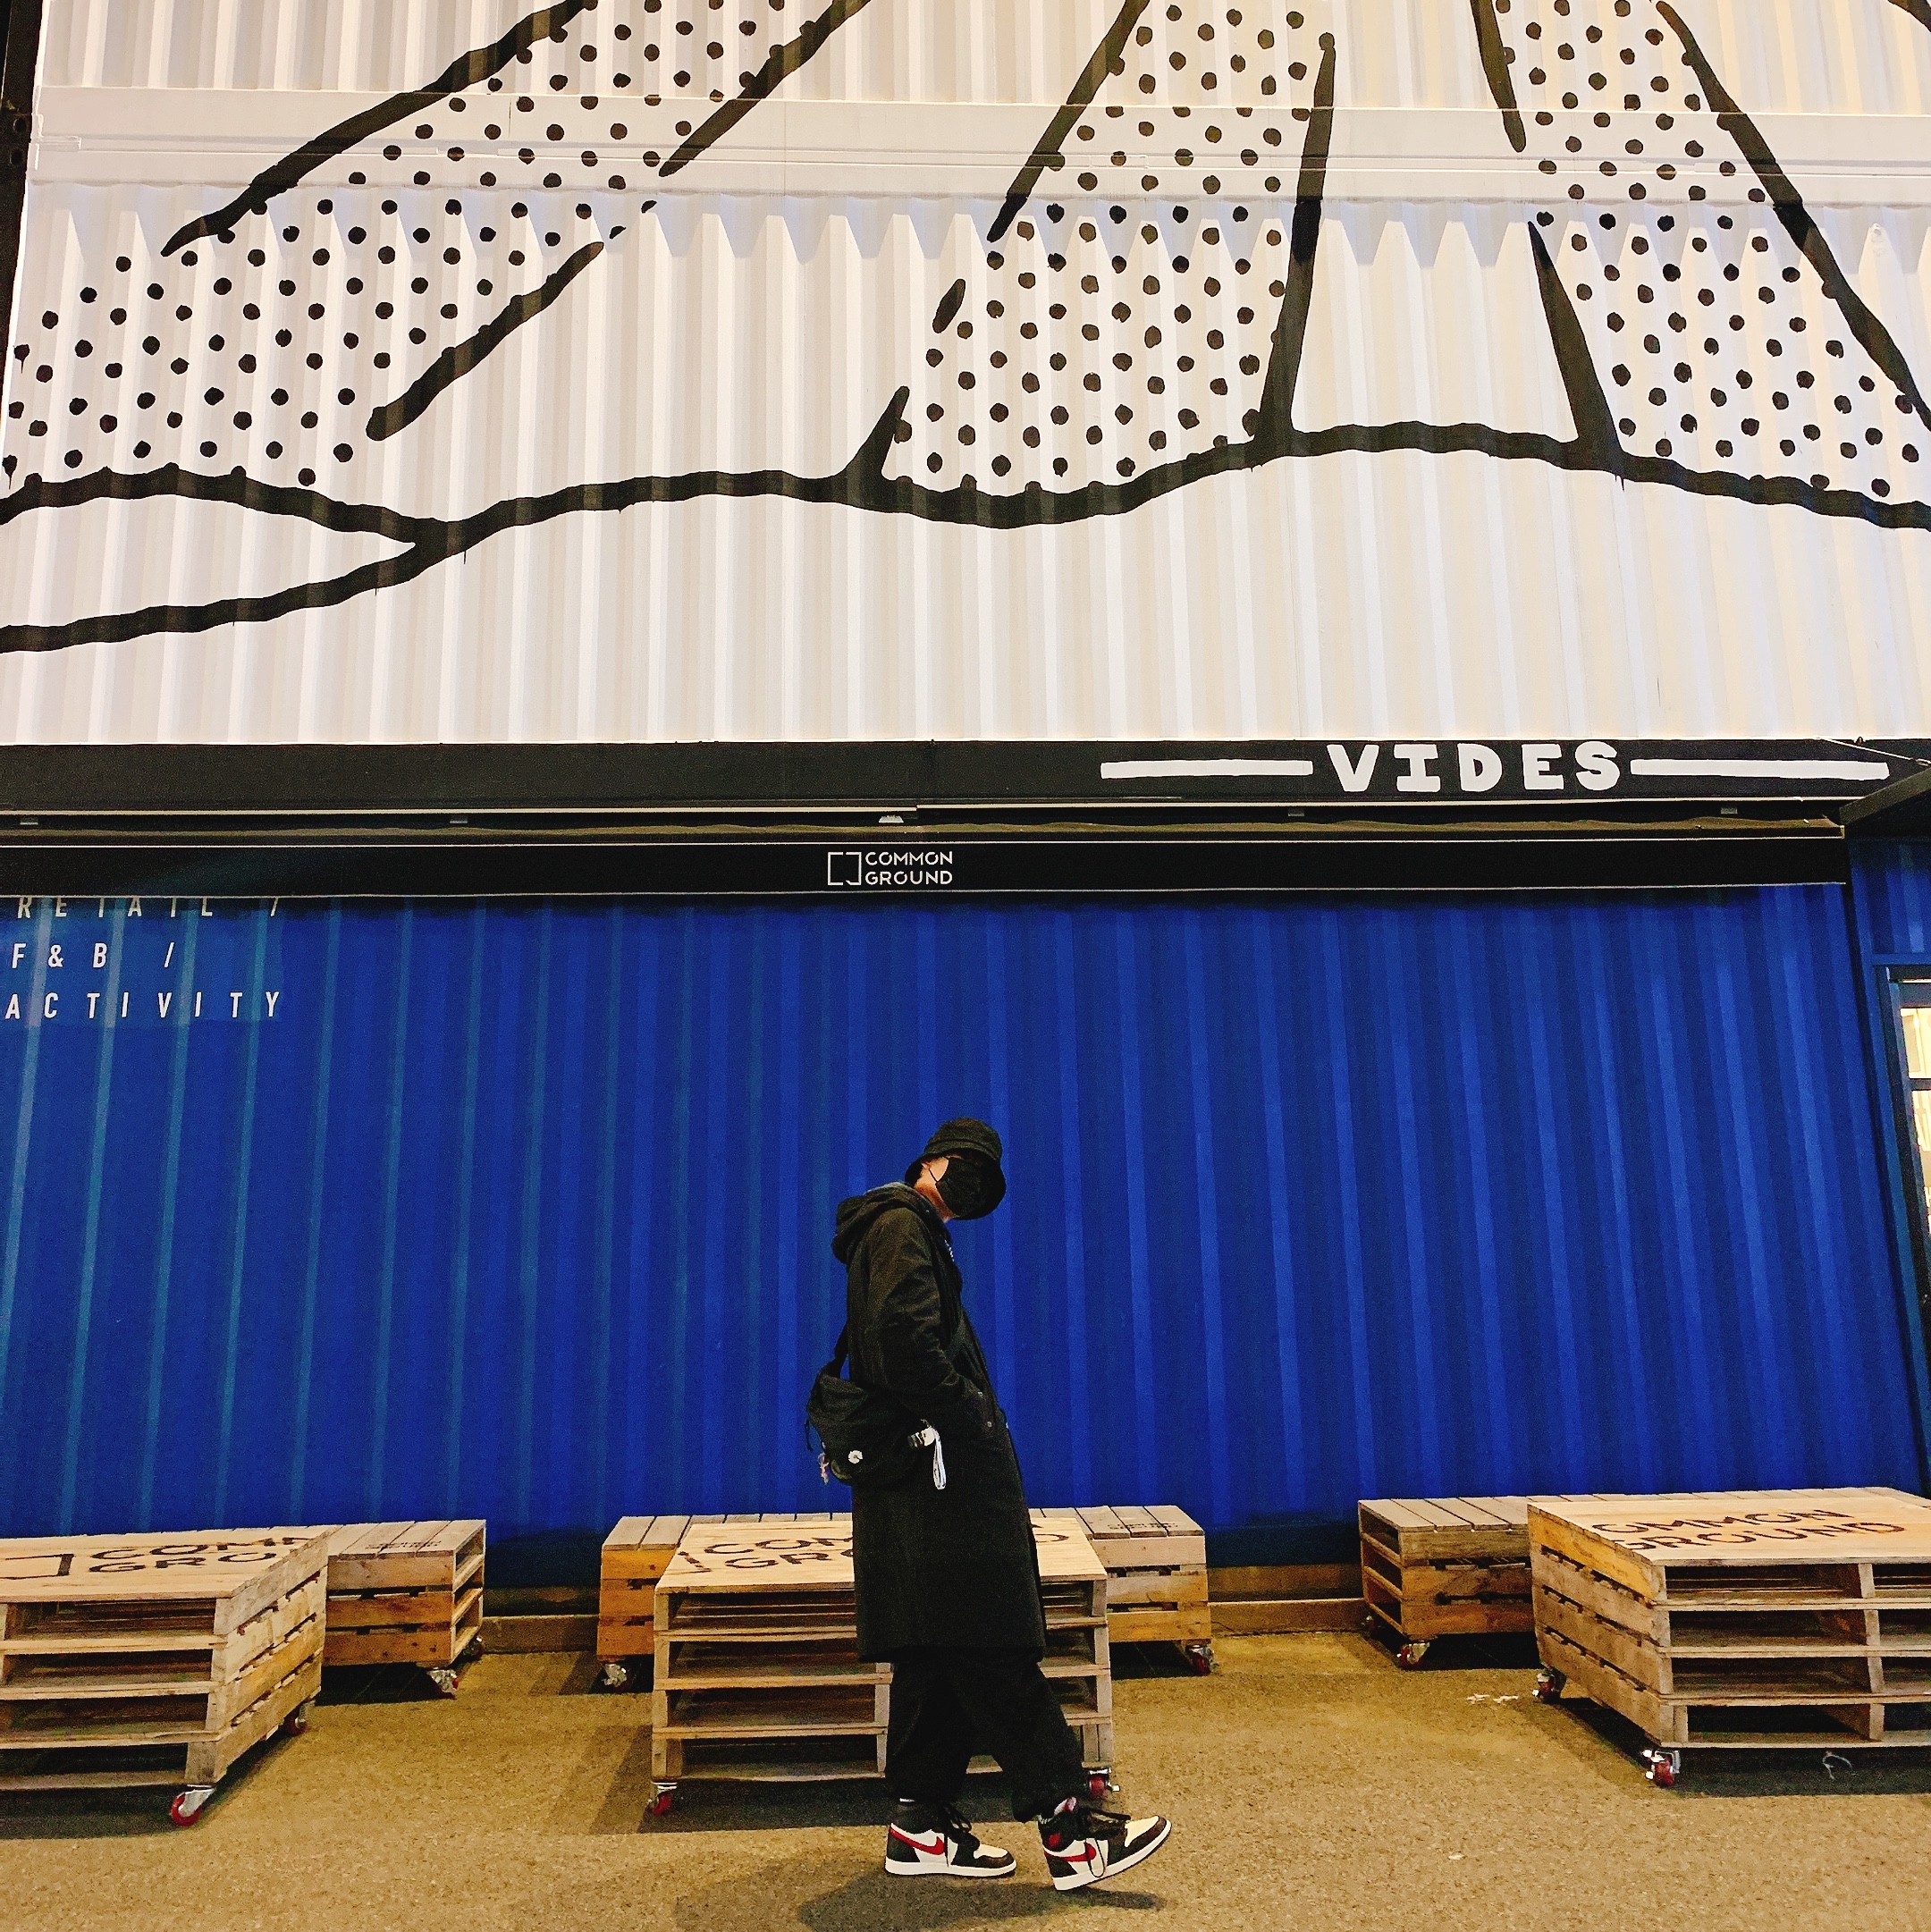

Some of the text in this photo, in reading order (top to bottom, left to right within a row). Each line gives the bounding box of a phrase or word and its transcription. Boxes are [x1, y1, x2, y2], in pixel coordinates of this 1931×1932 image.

[1326, 741, 1621, 793] VIDES
[864, 851, 953, 865] COMMON
[864, 871, 953, 885] GROUND
[5, 991, 279, 1019] ACTIVITY
[725, 1548, 853, 1569] GR
